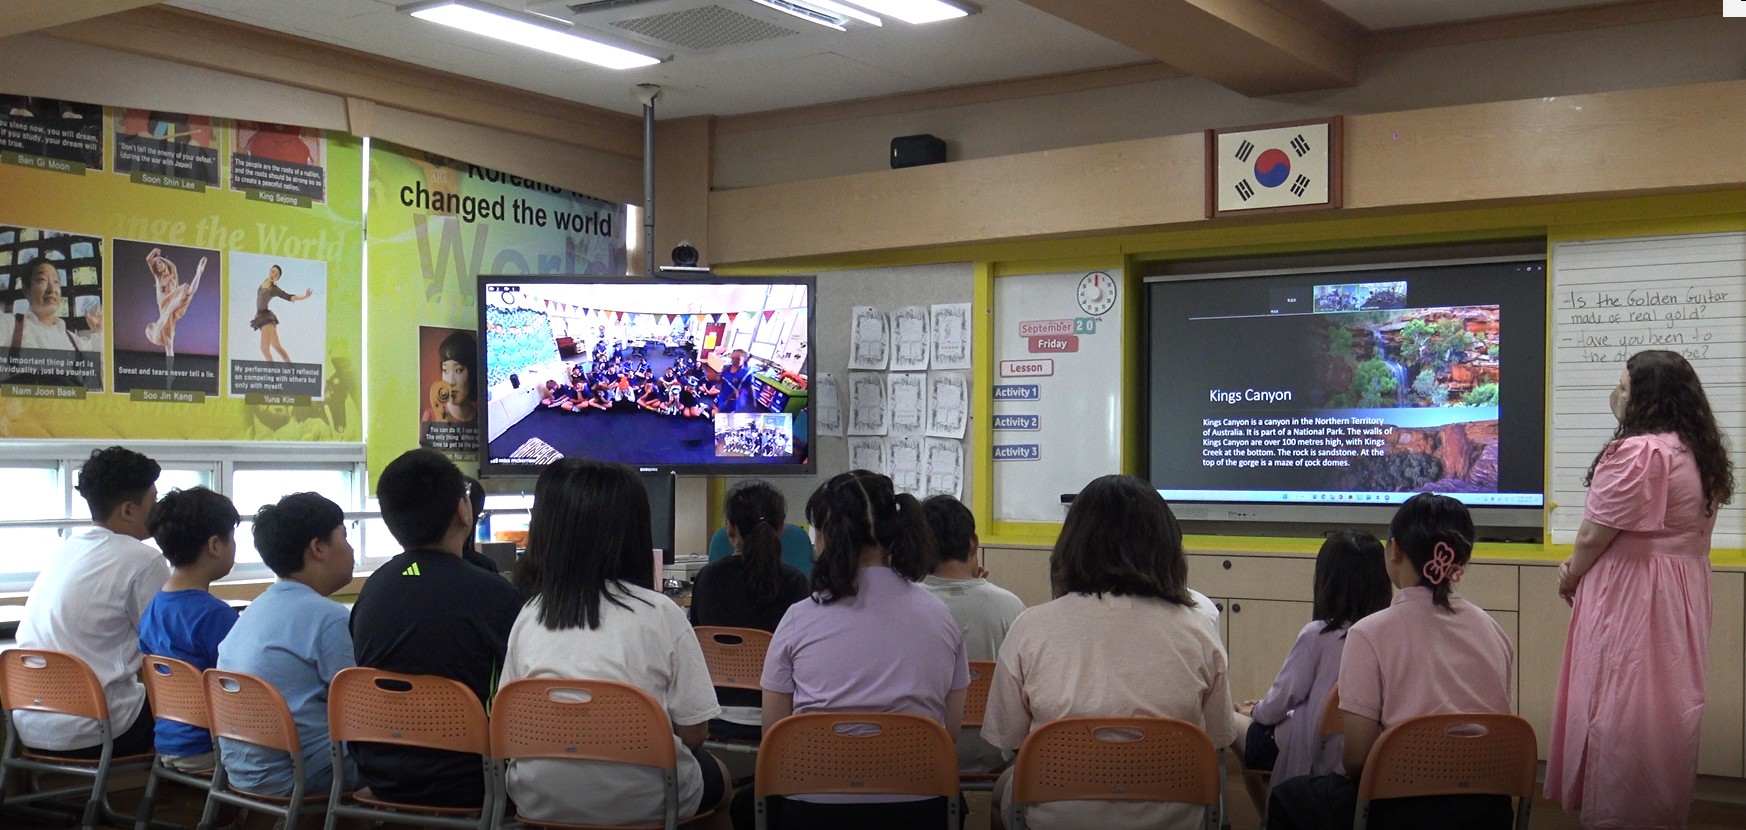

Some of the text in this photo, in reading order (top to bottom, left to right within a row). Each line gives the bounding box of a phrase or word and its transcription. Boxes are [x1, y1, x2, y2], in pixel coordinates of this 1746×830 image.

[18, 156, 70, 171] Ban Gi Moon
[142, 174, 195, 188] Soon Shin Lee
[260, 192, 297, 205] King Sejong
[400, 181, 612, 237] changed the world
[196, 214, 346, 262] the World
[1597, 292, 1622, 307] the
[1628, 289, 1677, 306] Golden
[1686, 286, 1728, 304] Guitar
[1571, 306, 1706, 328] made of real gold?
[1022, 322, 1072, 334] September
[1038, 339, 1067, 350] Friday
[1620, 335, 1644, 350] you
[1648, 328, 1683, 344] been
[1692, 328, 1712, 342] to
[1584, 349, 1606, 362] the
[10, 357, 45, 365] important
[47, 358, 65, 367] thing
[41, 367, 54, 375] just
[66, 369, 96, 377] yourself.
[118, 366, 137, 374] Sweat
[152, 368, 168, 376] tears
[1011, 363, 1042, 373] Lesson
[12, 387, 31, 395] Nam
[35, 388, 54, 396] Joon
[160, 392, 171, 400] Jin
[174, 393, 193, 402] Kang
[995, 387, 1037, 398] Activity 1
[1210, 388, 1291, 404] Kings Canyon
[282, 396, 295, 404] Kim
[995, 417, 1037, 428] Activity 2
[1203, 419, 1221, 427] Kings
[1223, 418, 1249, 427] Canyon
[1315, 417, 1349, 425] Northern
[1351, 417, 1384, 425] Territory
[1261, 429, 1276, 437] part
[1203, 439, 1221, 447] Kings
[1223, 439, 1249, 447] Canyon
[1325, 438, 1343, 447] high,
[1364, 438, 1385, 447] Kings
[995, 447, 1037, 457] Activity 3
[1203, 459, 1215, 467] top
